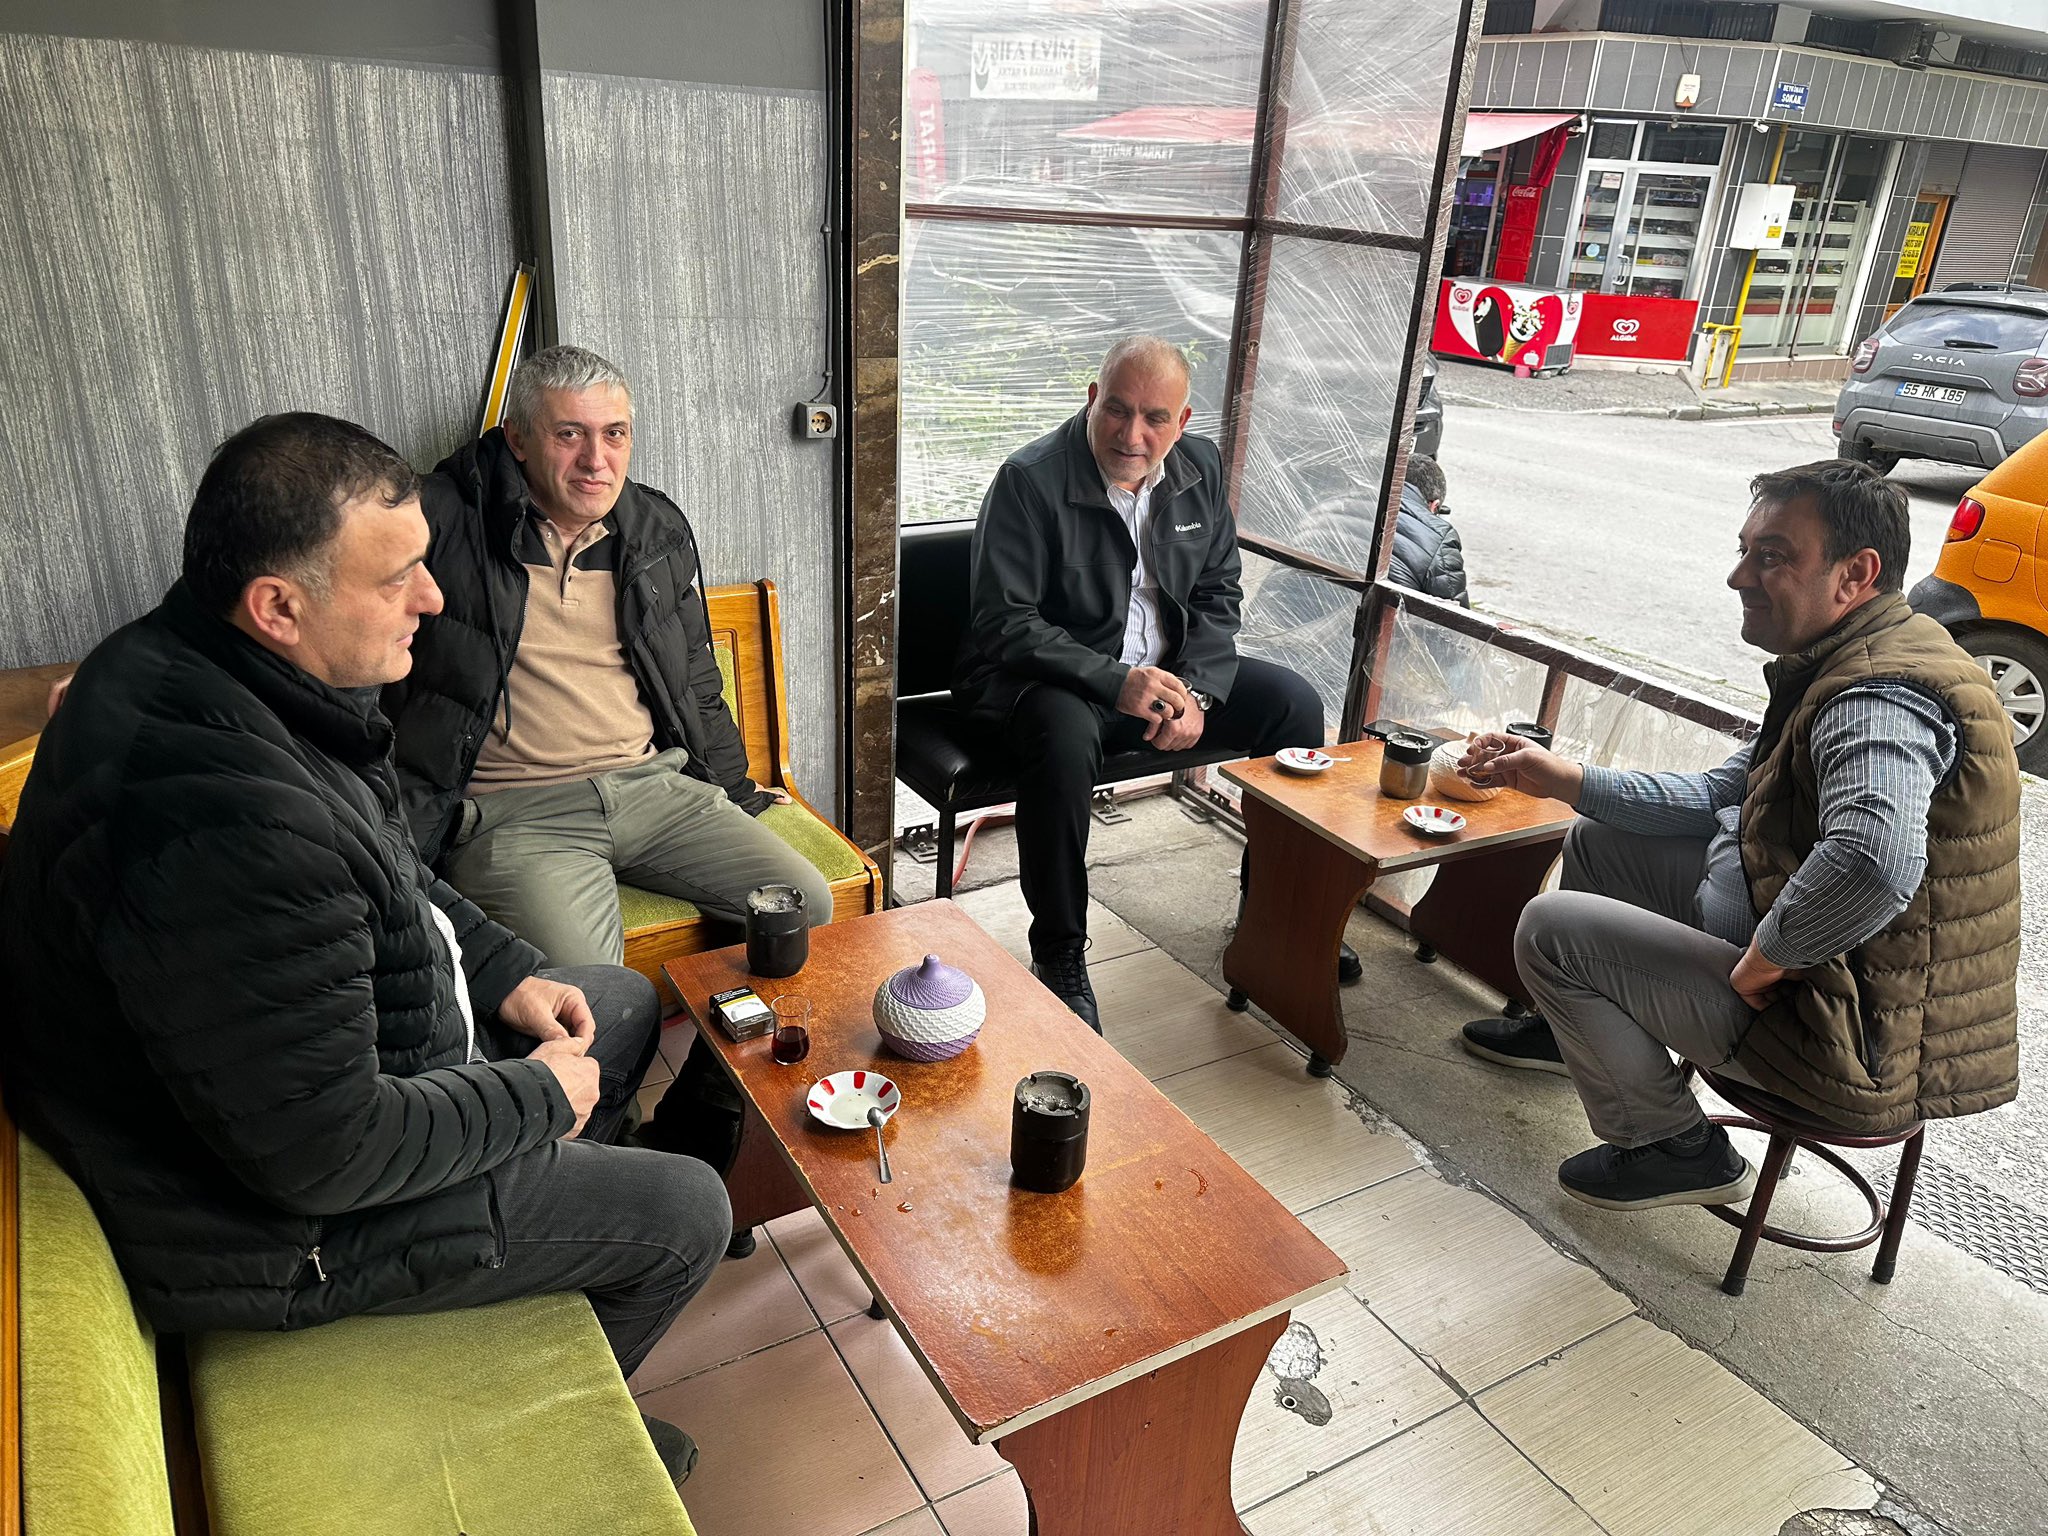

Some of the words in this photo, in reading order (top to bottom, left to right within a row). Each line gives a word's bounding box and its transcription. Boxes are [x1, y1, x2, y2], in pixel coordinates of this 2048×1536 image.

[1781, 93, 1802, 105] SOKAK
[1610, 334, 1637, 342] ALGIDA
[1912, 353, 1965, 366] DACIA
[1903, 383, 1919, 395] 55
[1921, 387, 1938, 399] HK
[1941, 390, 1964, 402] 185
